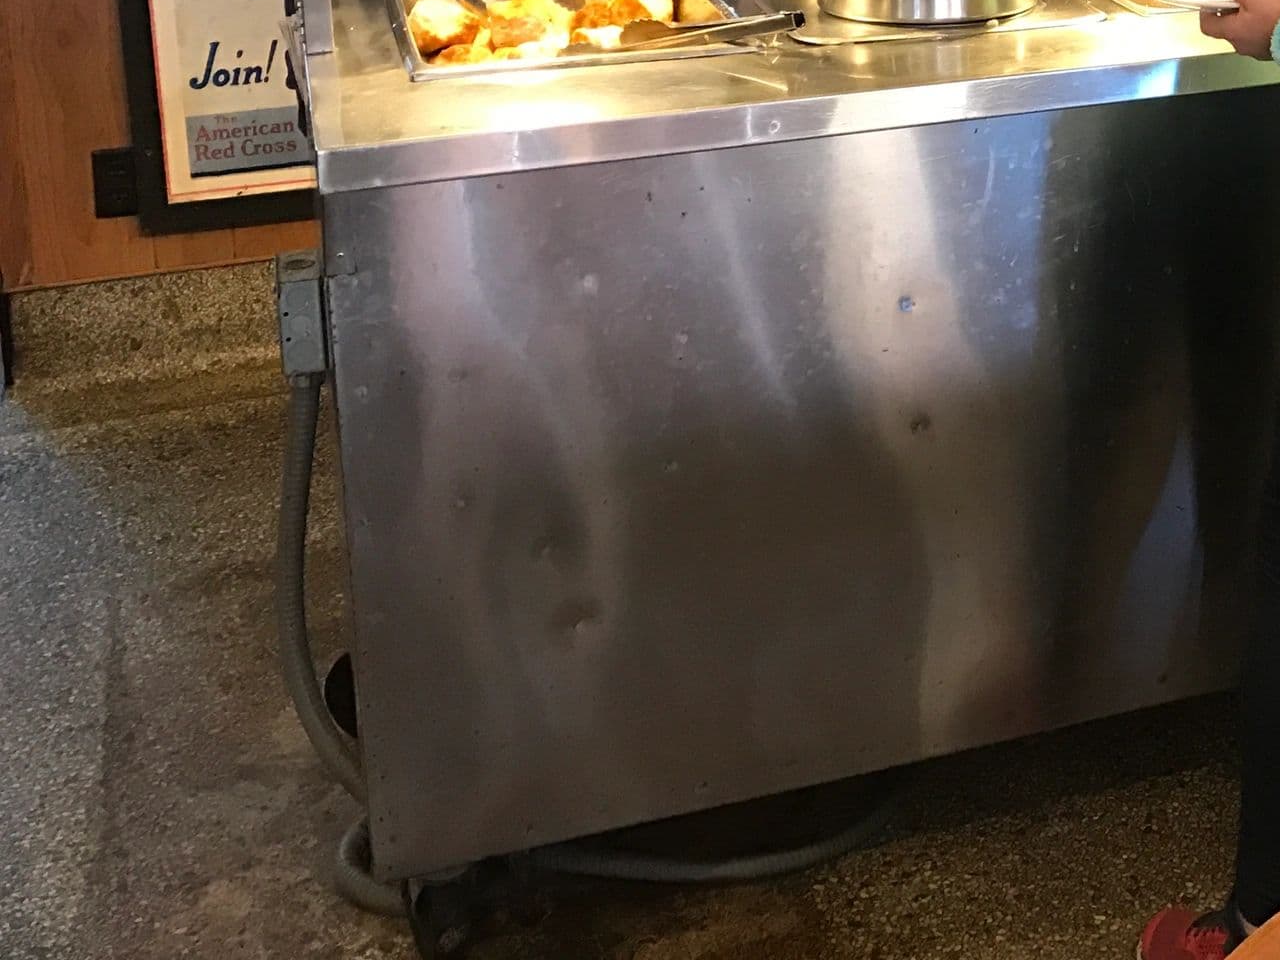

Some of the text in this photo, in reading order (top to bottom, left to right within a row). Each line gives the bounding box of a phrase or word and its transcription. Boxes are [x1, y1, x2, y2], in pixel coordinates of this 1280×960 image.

[189, 39, 279, 90] Join!
[214, 114, 239, 124] The
[196, 120, 295, 142] American
[194, 138, 297, 161] Red Cross
